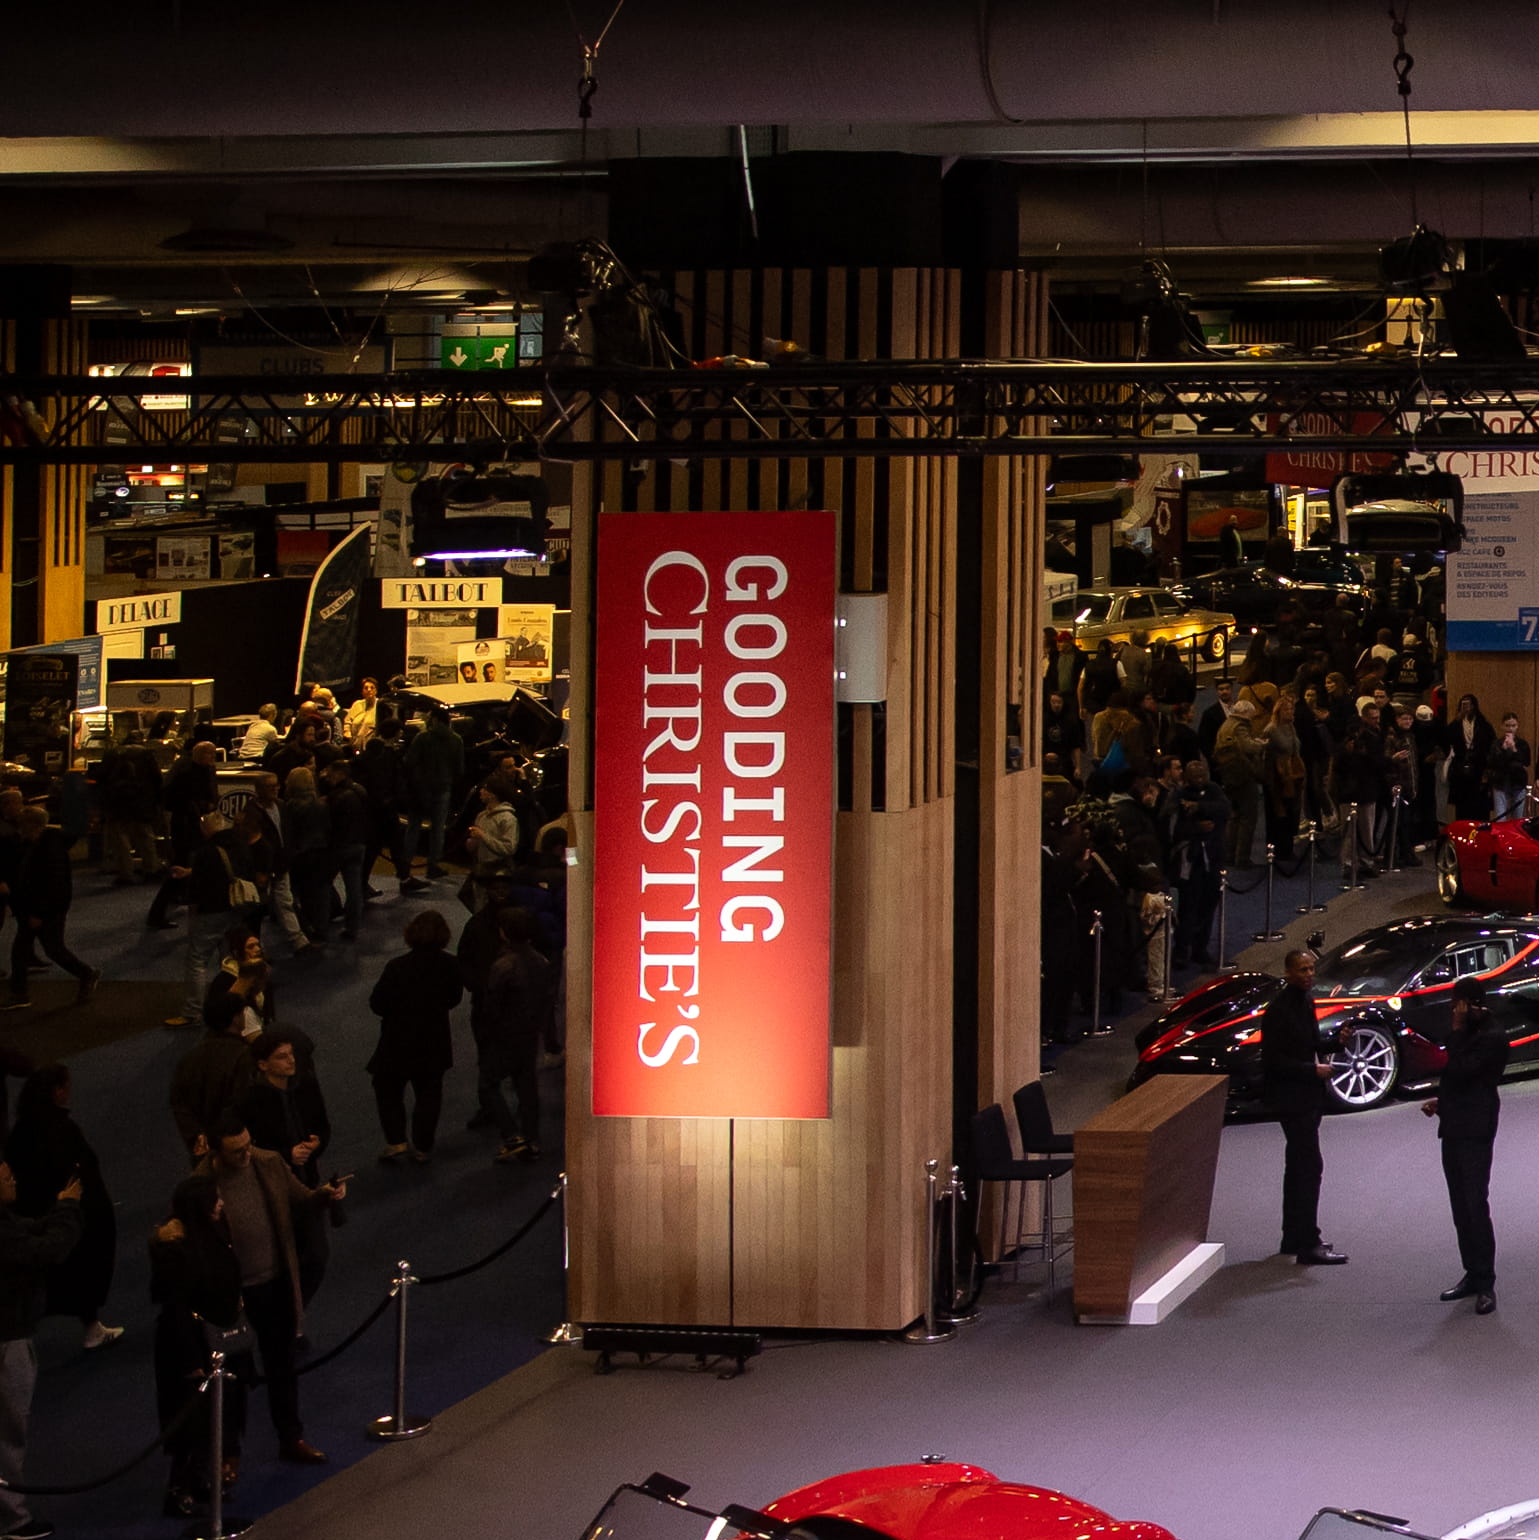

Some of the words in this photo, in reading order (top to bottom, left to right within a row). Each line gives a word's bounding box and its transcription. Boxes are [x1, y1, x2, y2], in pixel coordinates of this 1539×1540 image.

[396, 582, 489, 602] TALBOT
[719, 554, 789, 943] GOODING
[637, 550, 710, 1068] CHRISTIE'S
